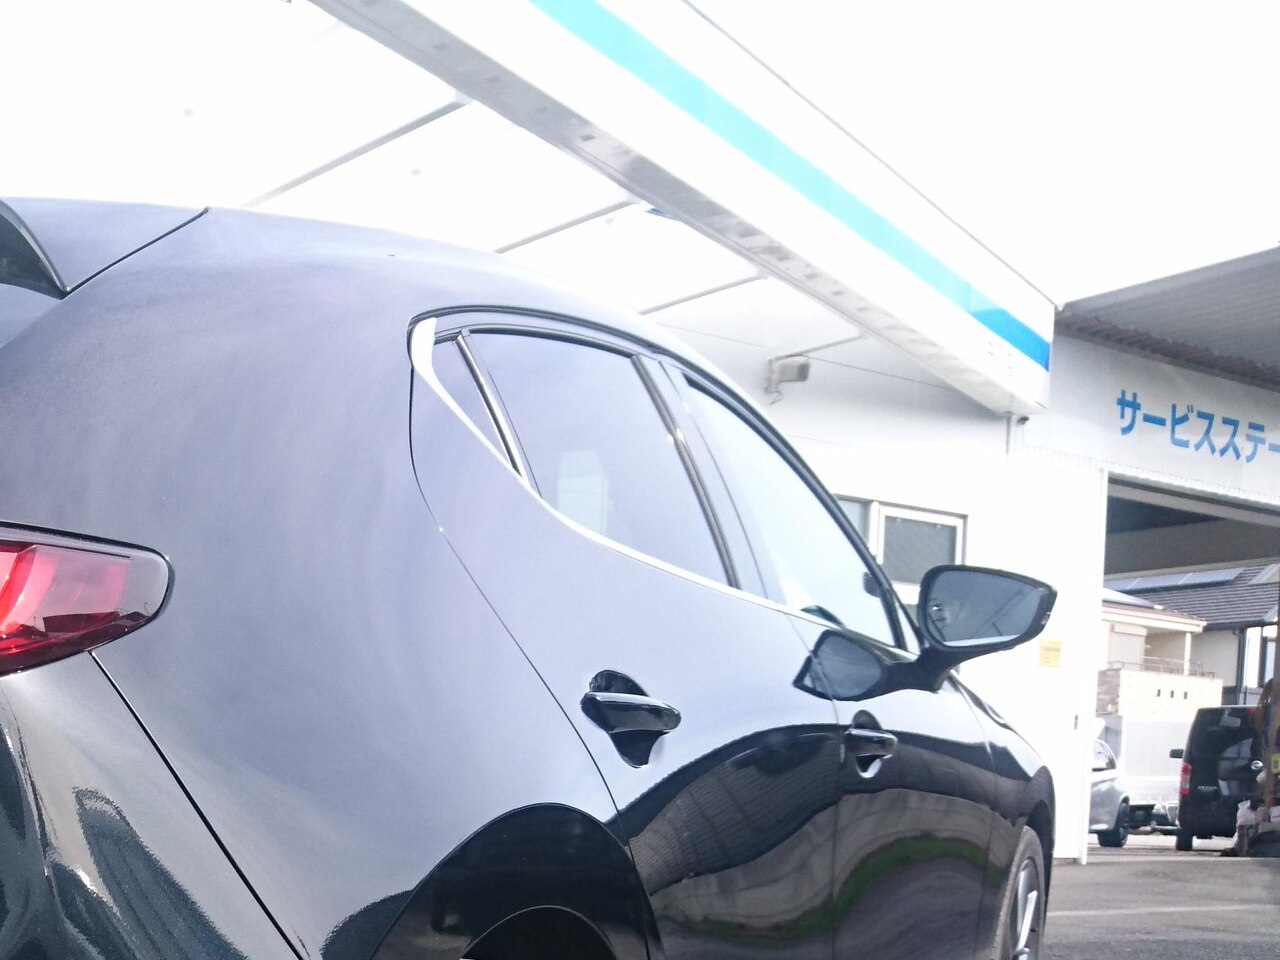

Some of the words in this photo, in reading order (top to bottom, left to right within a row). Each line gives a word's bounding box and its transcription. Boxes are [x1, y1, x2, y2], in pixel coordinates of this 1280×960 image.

[1116, 389, 1280, 463] サービスステー
